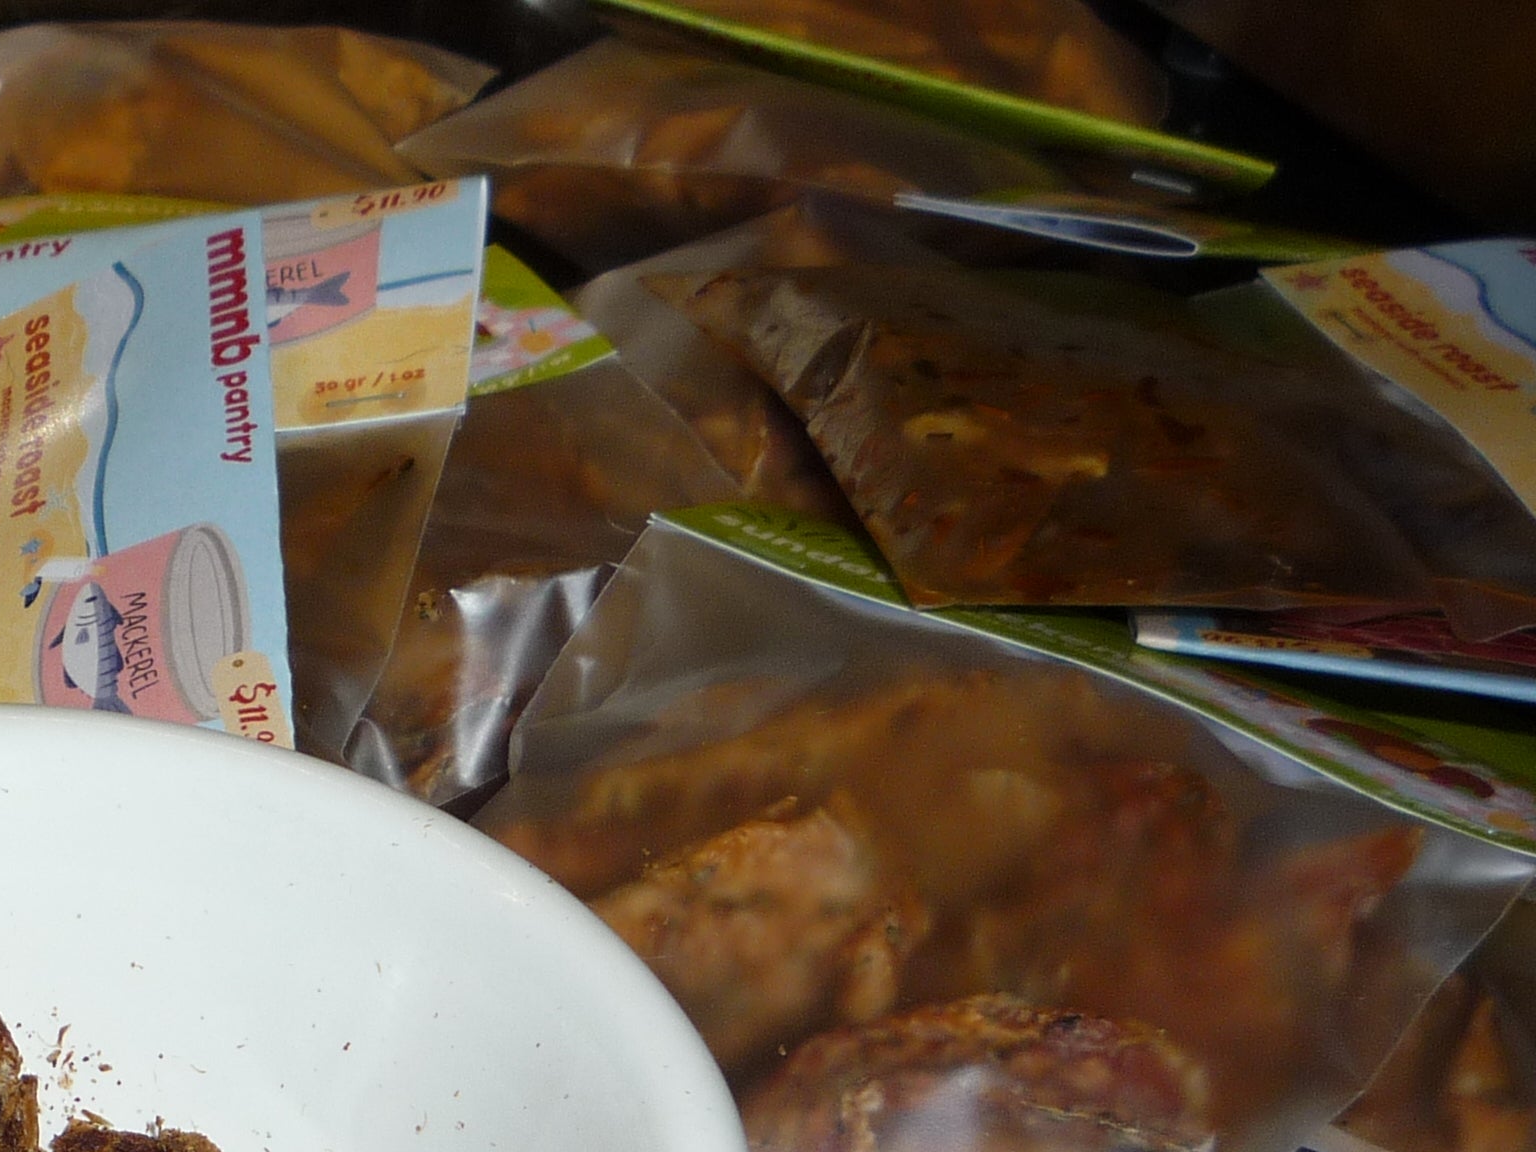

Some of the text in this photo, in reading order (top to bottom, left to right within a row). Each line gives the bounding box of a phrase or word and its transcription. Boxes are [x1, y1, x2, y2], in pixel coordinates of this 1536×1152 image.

[206, 227, 261, 465] mmnb pantry
[119, 591, 161, 700] MACKEREL
